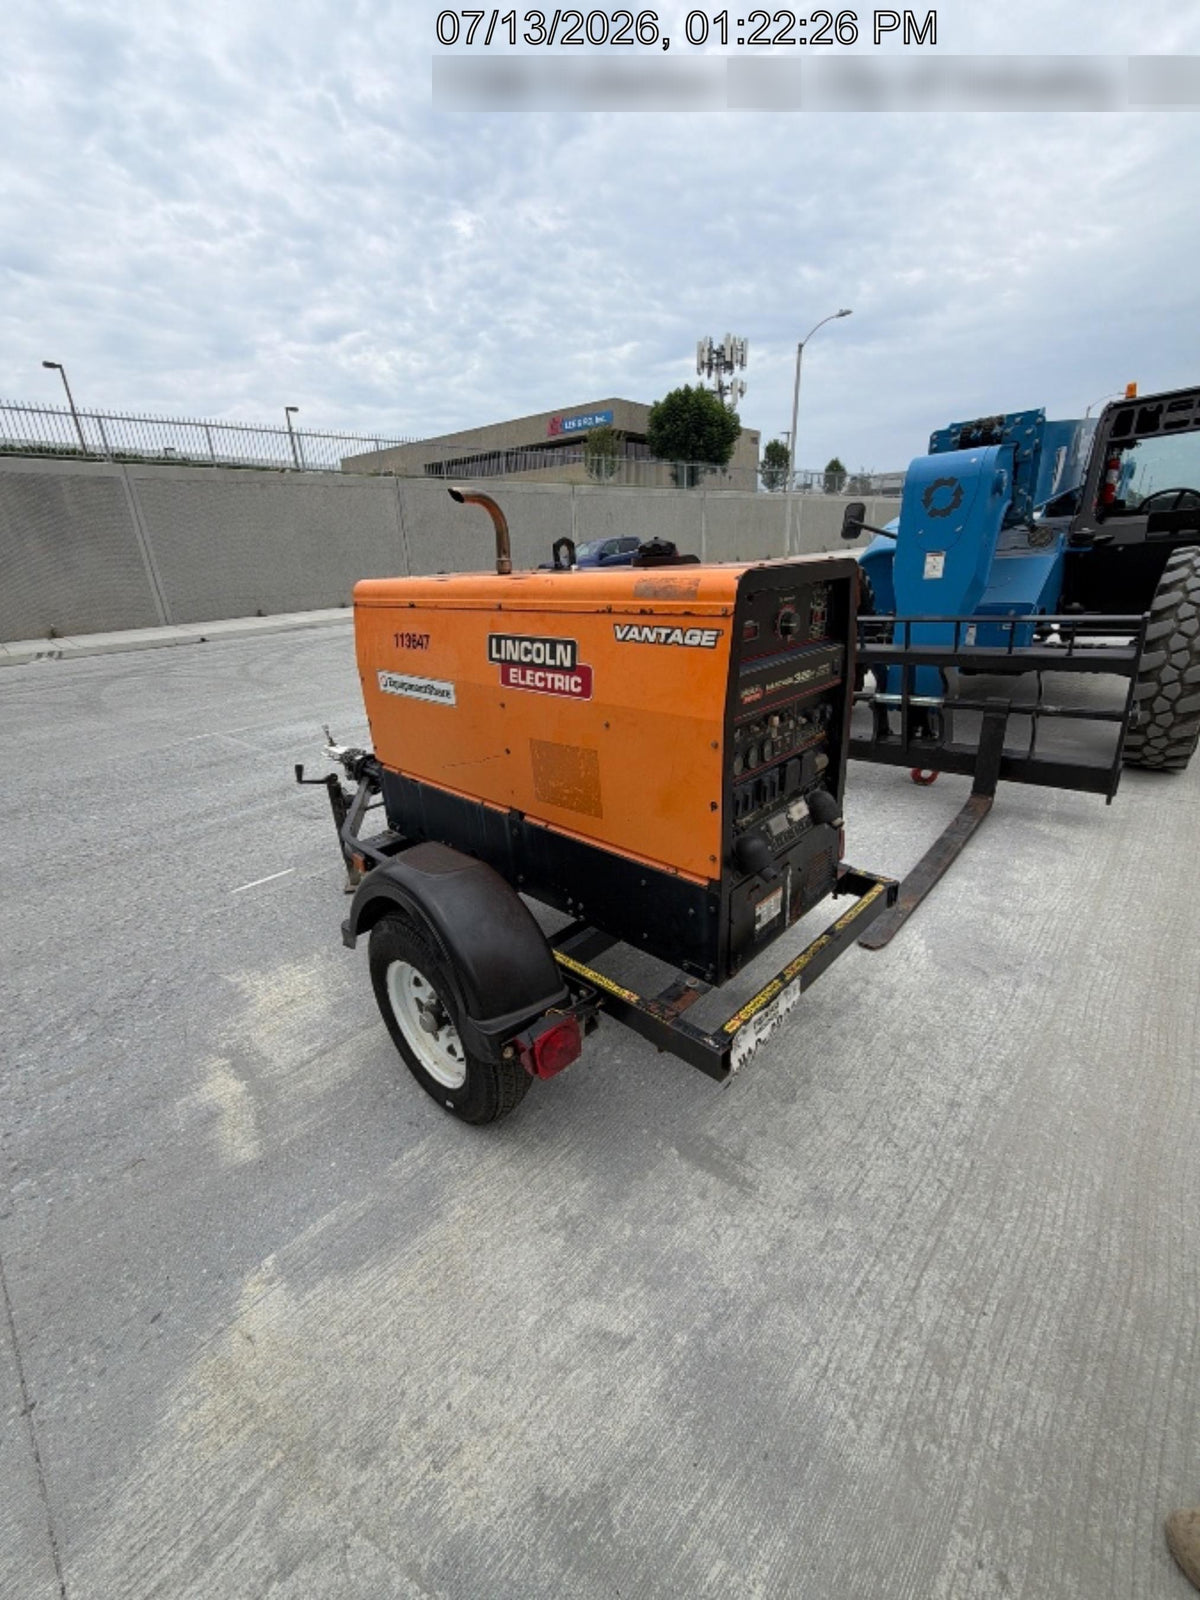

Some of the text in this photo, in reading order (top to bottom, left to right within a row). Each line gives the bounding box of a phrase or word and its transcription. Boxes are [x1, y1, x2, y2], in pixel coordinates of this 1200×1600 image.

[614, 625, 720, 646] VANTAGE
[491, 637, 571, 667] LINCOLN
[509, 668, 582, 692] ELECTRIC
